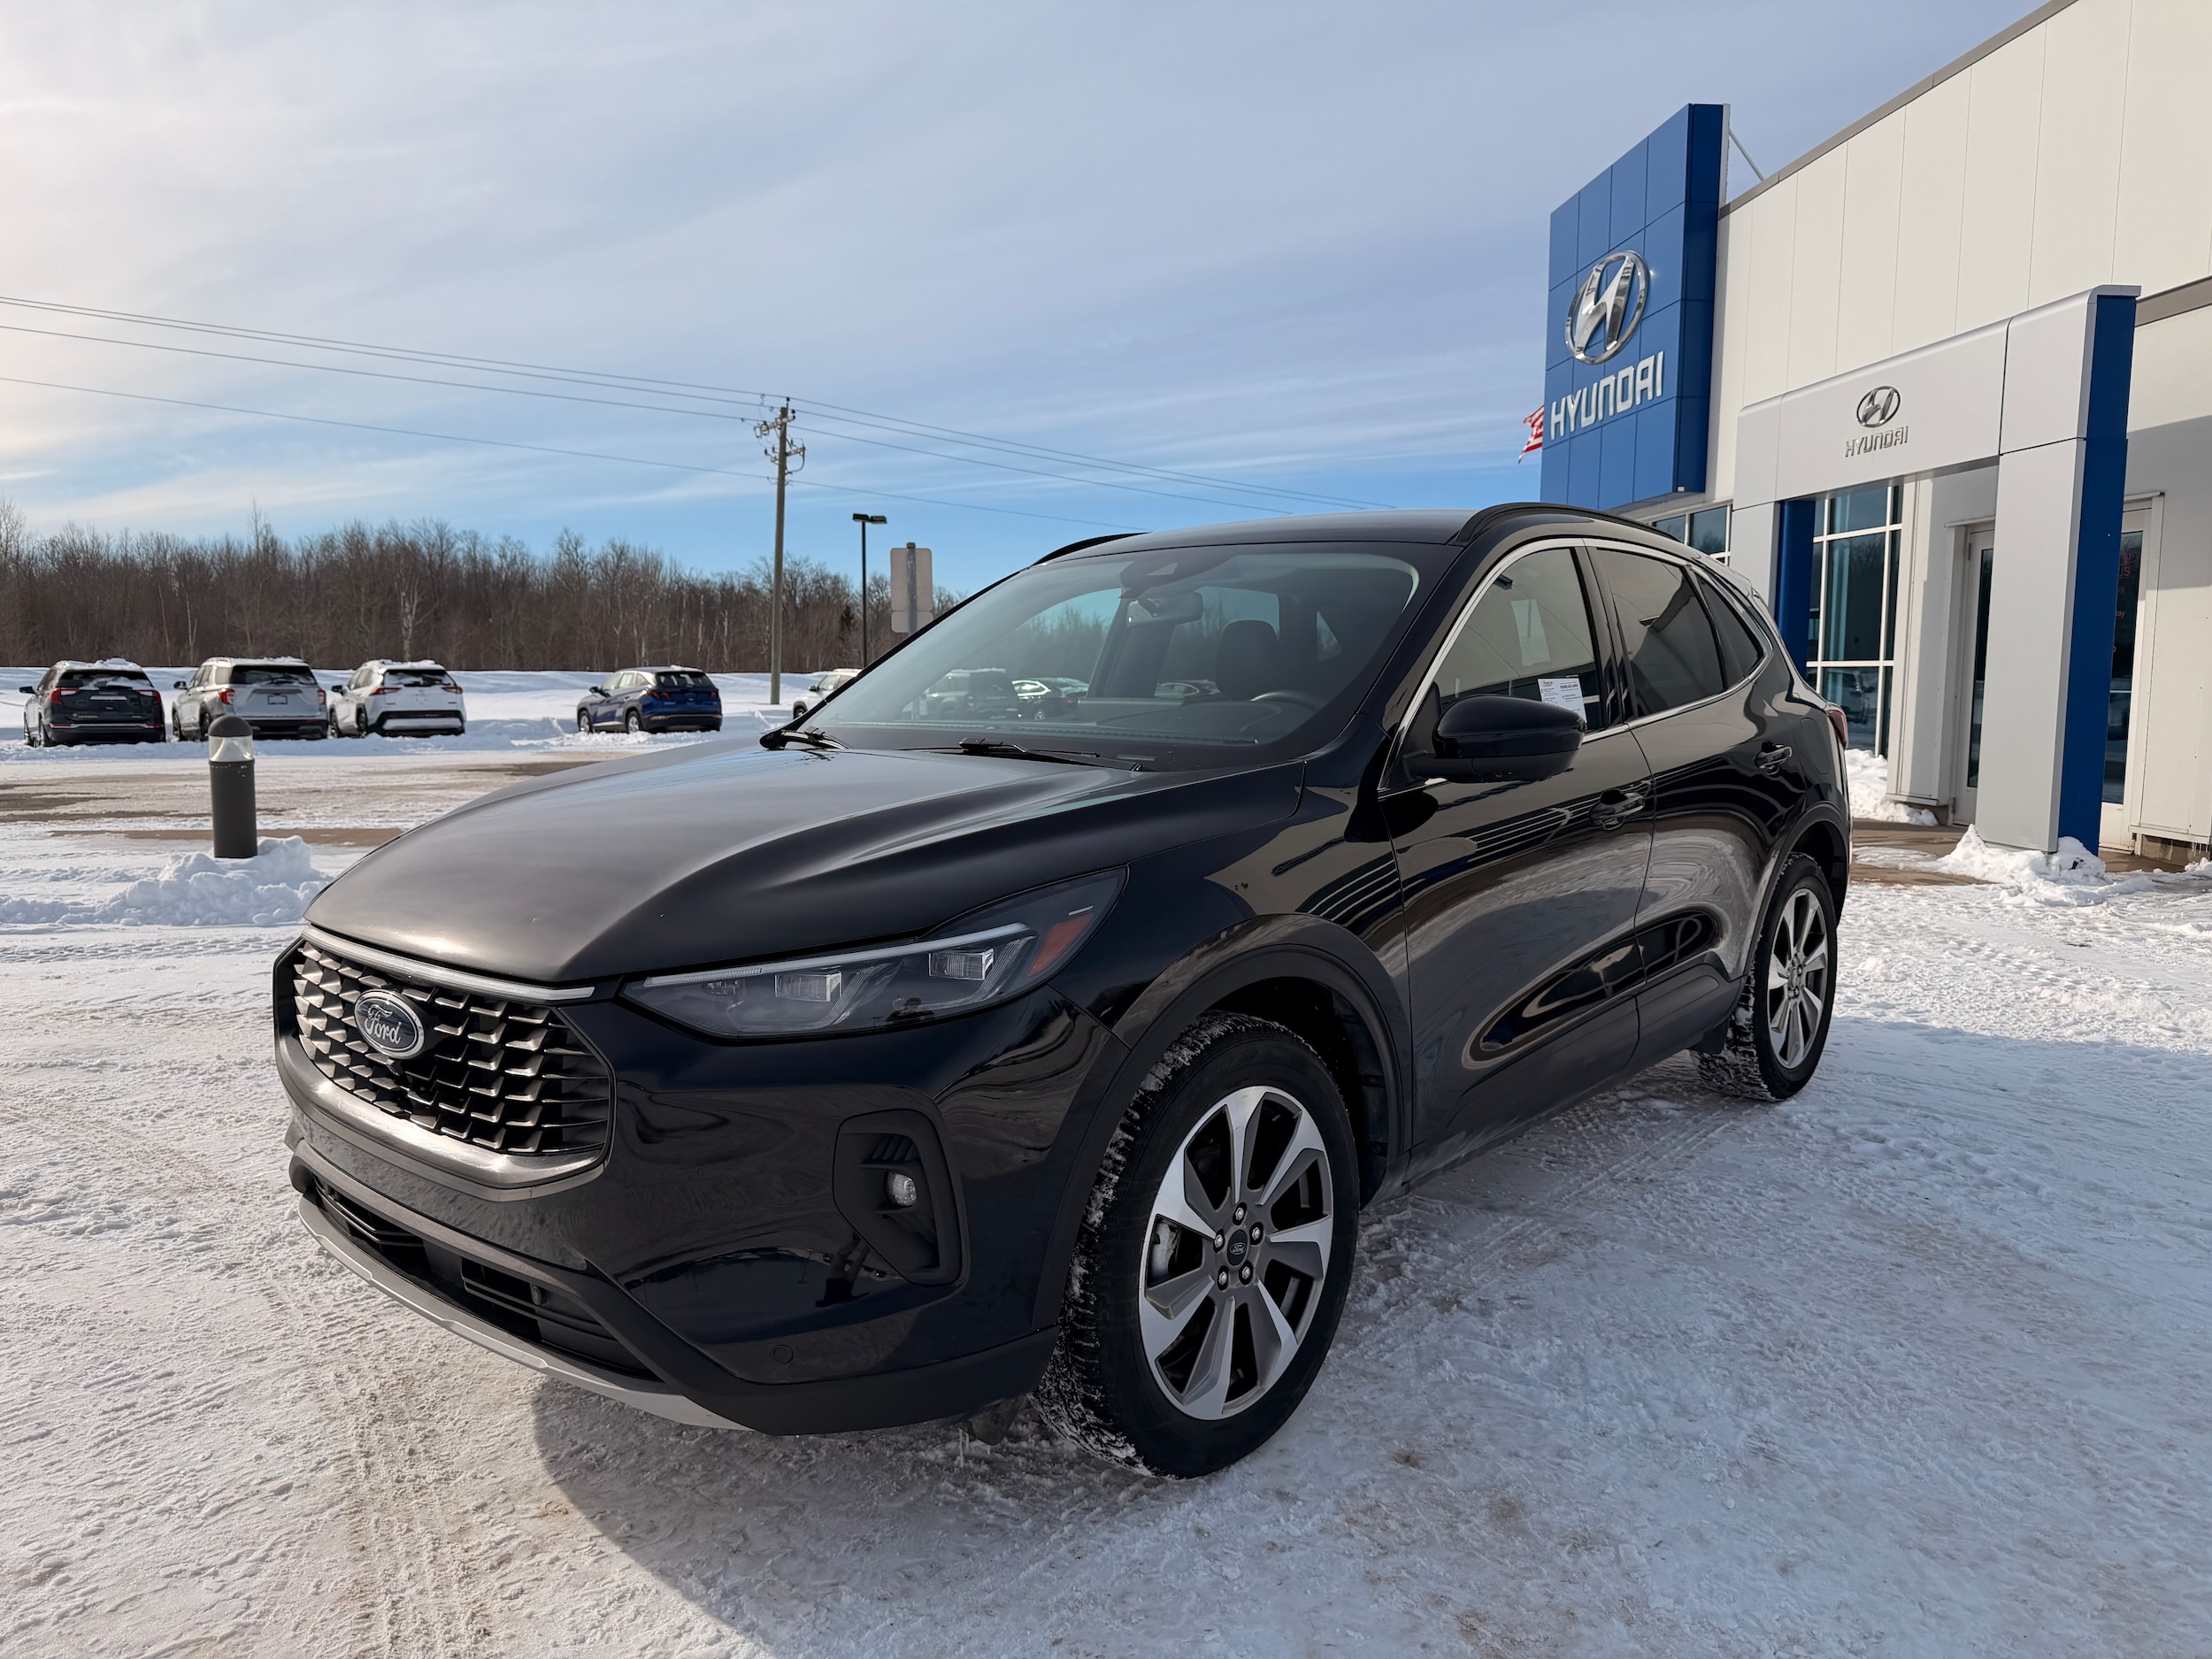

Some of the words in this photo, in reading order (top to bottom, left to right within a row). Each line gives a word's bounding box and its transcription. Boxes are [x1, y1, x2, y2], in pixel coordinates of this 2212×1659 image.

[1550, 350, 1664, 441] HYUNDAI
[1845, 425, 1909, 457] HYUNDAI
[365, 1003, 403, 1044] Ford
